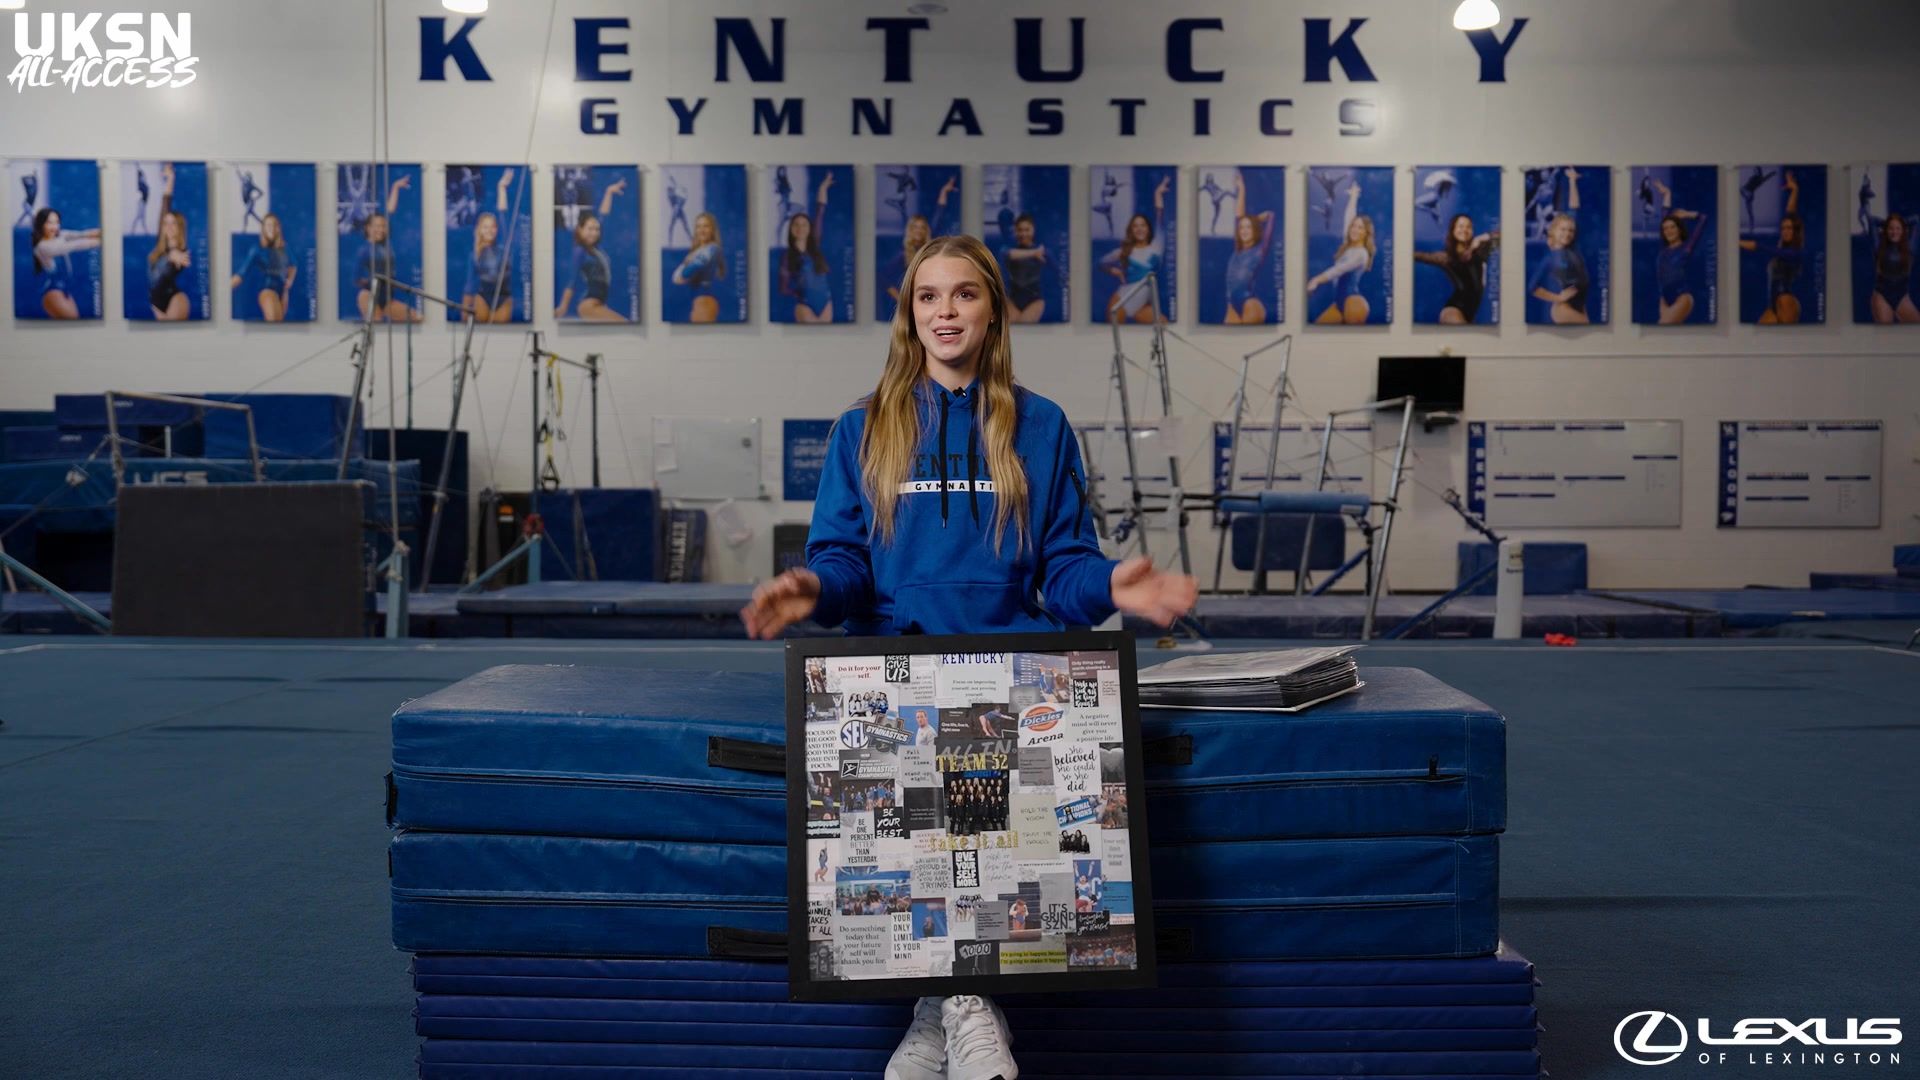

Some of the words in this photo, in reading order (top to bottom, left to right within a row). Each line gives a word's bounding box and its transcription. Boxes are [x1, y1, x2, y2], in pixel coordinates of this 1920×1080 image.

[418, 17, 1530, 82] KENTUCKY
[580, 97, 1376, 136] GYMNASTICS
[942, 653, 1005, 664] KENTUCKY
[886, 660, 909, 669] GIVE
[886, 668, 909, 682] UP
[1023, 713, 1061, 726] Dickies
[866, 725, 909, 742] GYMNASTICS
[1027, 732, 1064, 746] Arena
[936, 752, 987, 773] TEAM
[992, 754, 1009, 770] 52
[1054, 749, 1096, 766] believed
[1073, 761, 1096, 771] could
[1067, 780, 1087, 792] did
[882, 808, 894, 817] BE
[877, 817, 900, 828] YOUR
[876, 829, 903, 838] BEST
[996, 831, 1019, 849] all
[955, 851, 976, 862] LOVE
[956, 861, 976, 870] YOUR
[956, 870, 977, 879] SELF
[956, 879, 978, 887] MORE
[1049, 904, 1068, 913] IT'S
[893, 914, 911, 922] YOUR
[1041, 912, 1076, 921] GRIND
[893, 924, 910, 932] ONLY
[1046, 921, 1072, 930] SZN.
[819, 926, 832, 936] ALL
[894, 943, 901, 951] IS
[903, 943, 921, 951] YOUR
